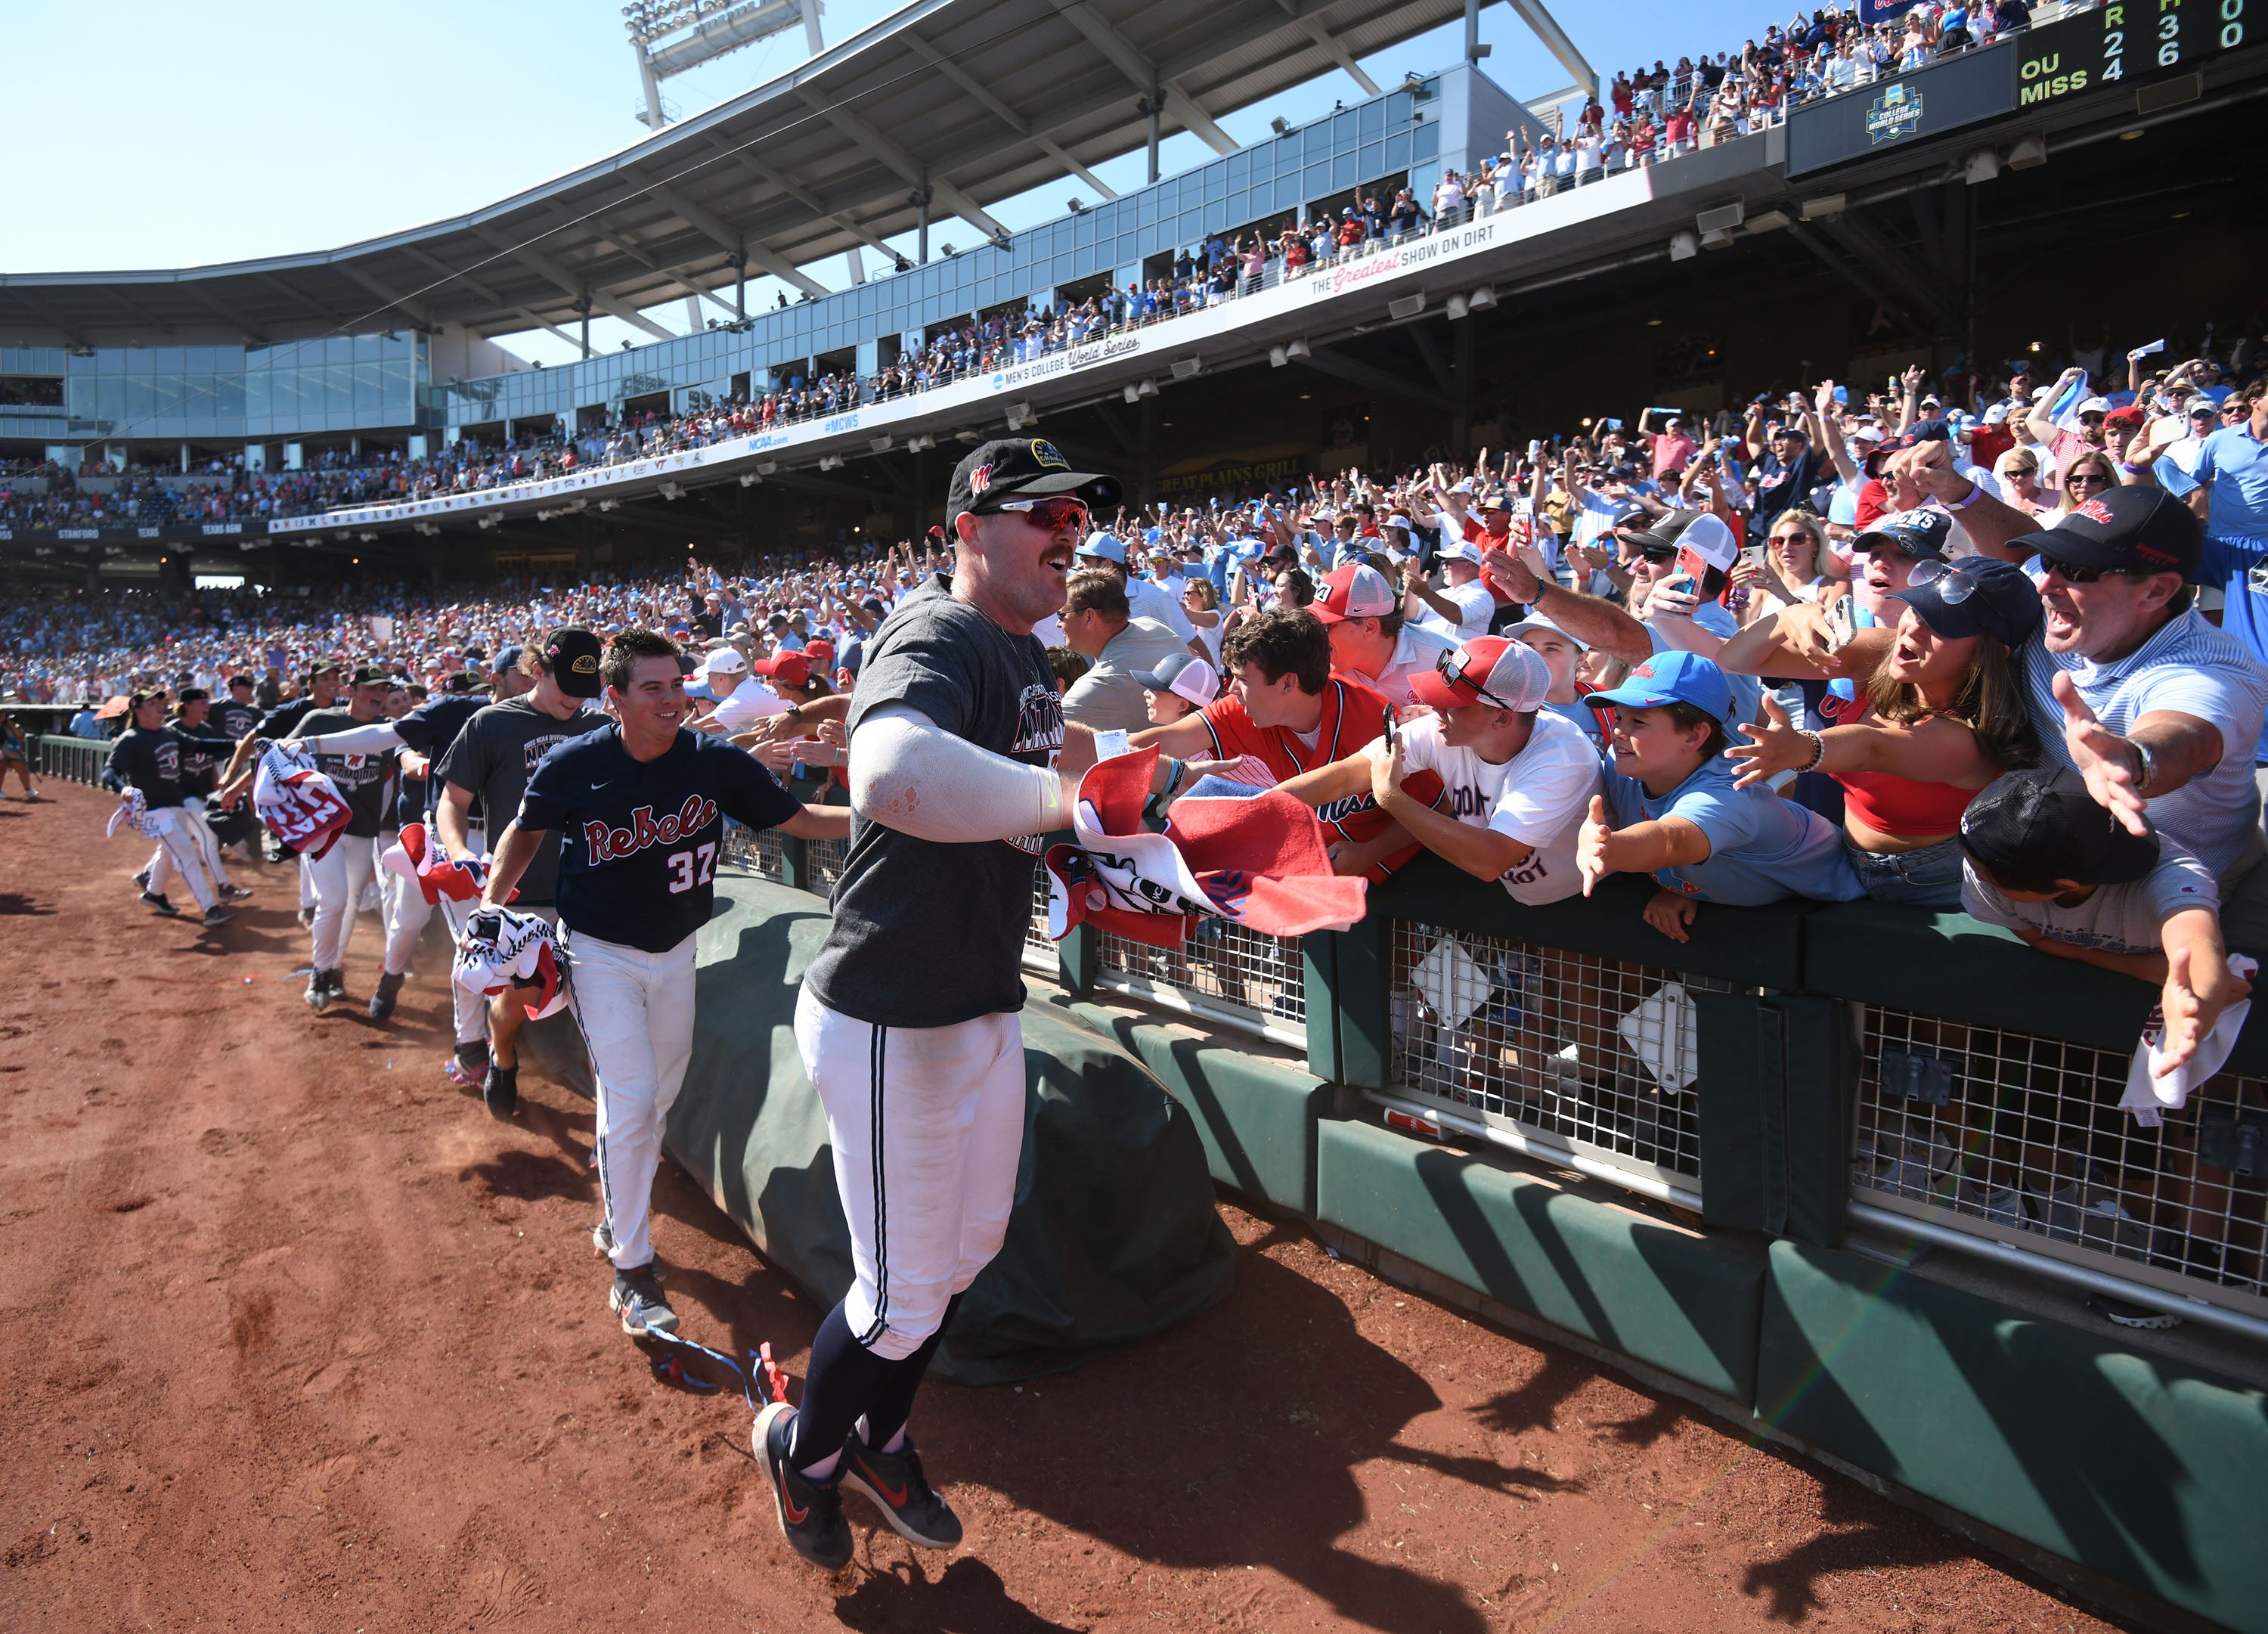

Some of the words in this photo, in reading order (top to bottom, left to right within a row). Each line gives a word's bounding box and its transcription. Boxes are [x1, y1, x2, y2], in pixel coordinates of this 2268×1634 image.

[2105, 5, 2125, 29] R
[2021, 52, 2059, 80] OU
[2104, 31, 2123, 58] 2
[2158, 14, 2179, 40] 3
[2220, 0, 2243, 21] 0
[2021, 70, 2087, 106] MISS
[2102, 57, 2123, 82] 4
[2158, 40, 2179, 67] 6
[2220, 22, 2243, 49] 0
[1868, 116, 1895, 131] WORLD
[1894, 108, 1920, 122] SERIES
[1879, 104, 1910, 120] COLLEGE
[1312, 276, 1332, 294] THE
[1332, 251, 1399, 293] Greatest
[1402, 242, 1438, 266] SHOW
[1442, 235, 1460, 254] ON
[1464, 225, 1495, 247] DIRT
[1005, 368, 1029, 386] MEN'S
[1031, 358, 1065, 377] COLLEGE
[1068, 347, 1101, 367] World
[1104, 337, 1141, 357] Series
[825, 414, 859, 433] #MCWS
[748, 436, 789, 451] NCAA.com
[1155, 474, 1198, 492] GREAT
[1199, 466, 1252, 486] PLAINS
[1253, 459, 1301, 479] GRILL
[57, 529, 100, 539] STANFORD
[138, 528, 160, 538] TEXAS
[201, 525, 225, 535] TEXAS
[582, 794, 718, 867] Rebels
[668, 840, 716, 895] 37
